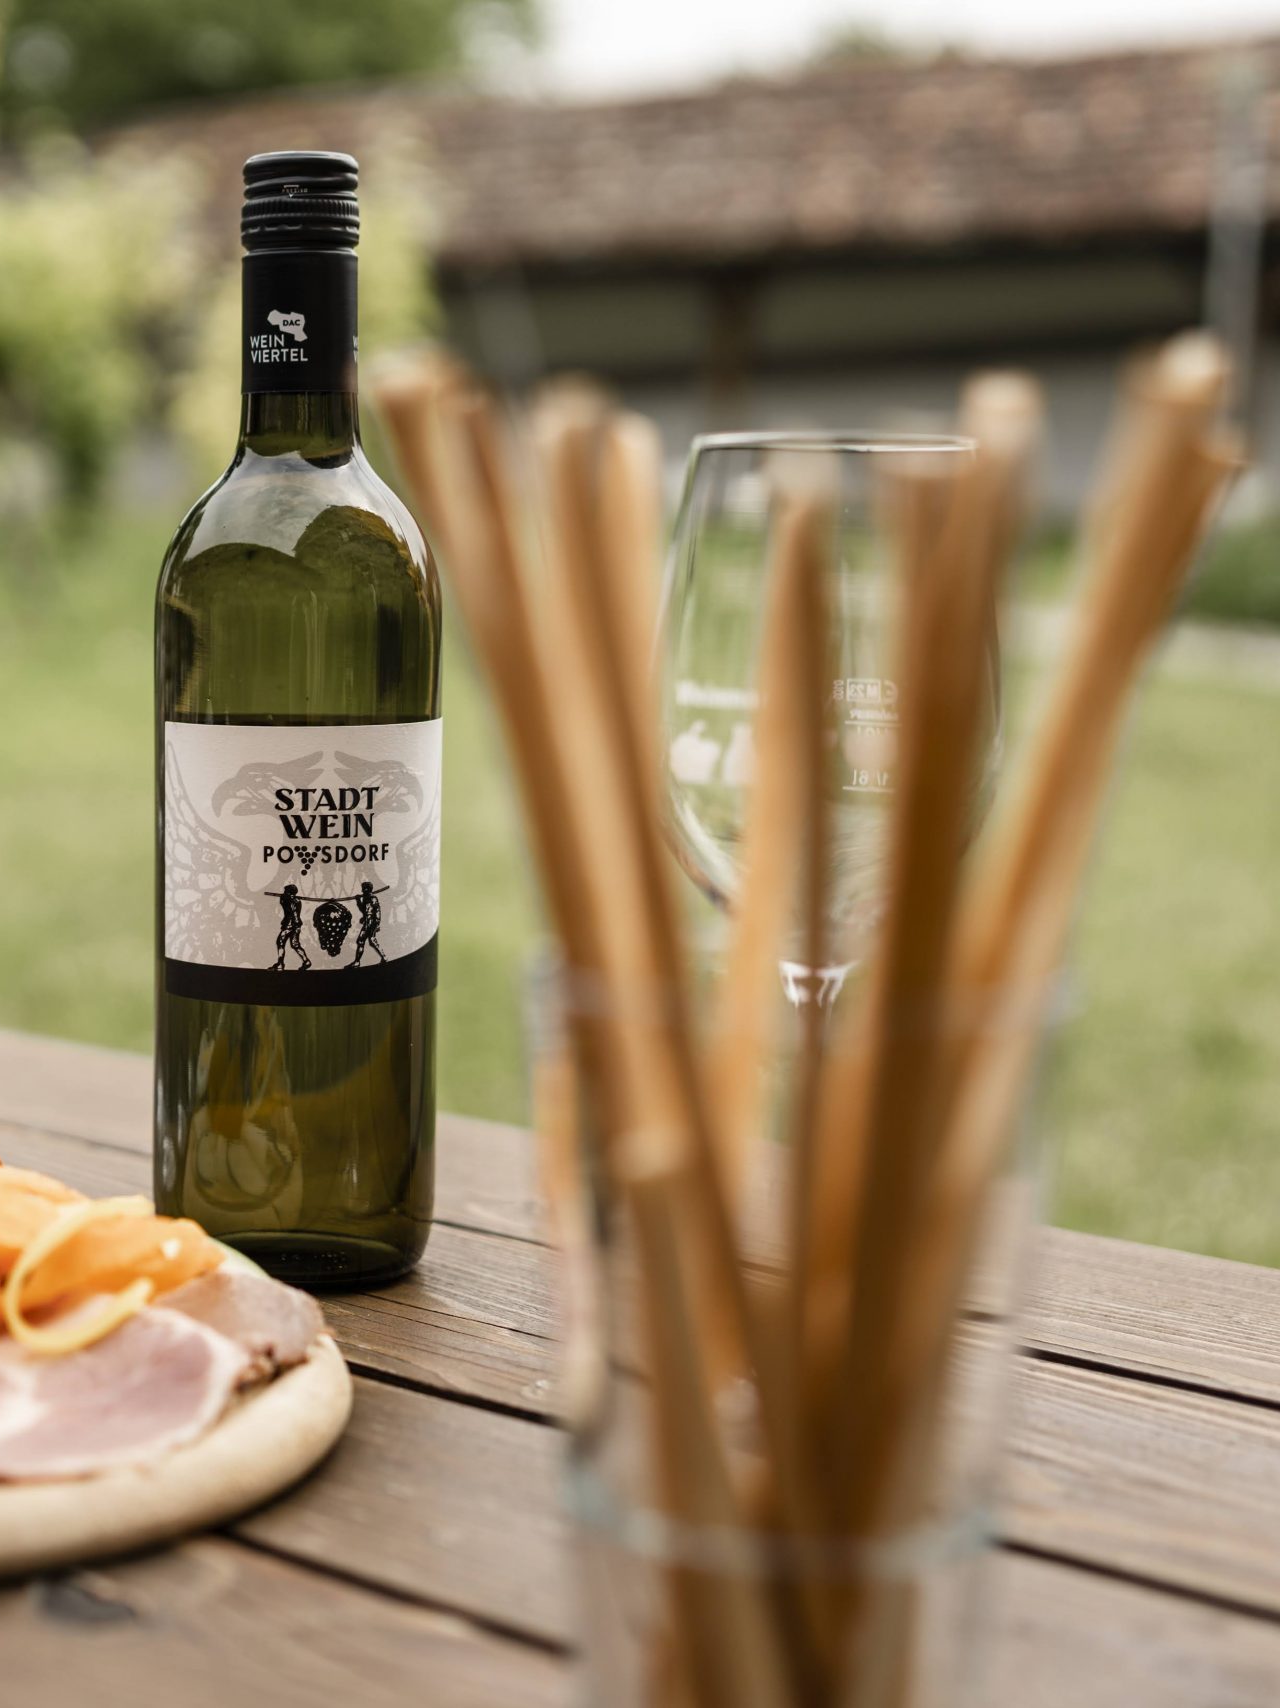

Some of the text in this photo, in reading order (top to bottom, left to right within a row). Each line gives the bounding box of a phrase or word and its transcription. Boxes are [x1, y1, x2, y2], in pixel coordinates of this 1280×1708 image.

[282, 319, 301, 327] DAC
[250, 334, 285, 349] WEIN
[250, 348, 308, 363] VIERTEL
[274, 786, 380, 812] STADT
[279, 812, 375, 839] WEIN
[263, 843, 389, 876] POYSDORF
